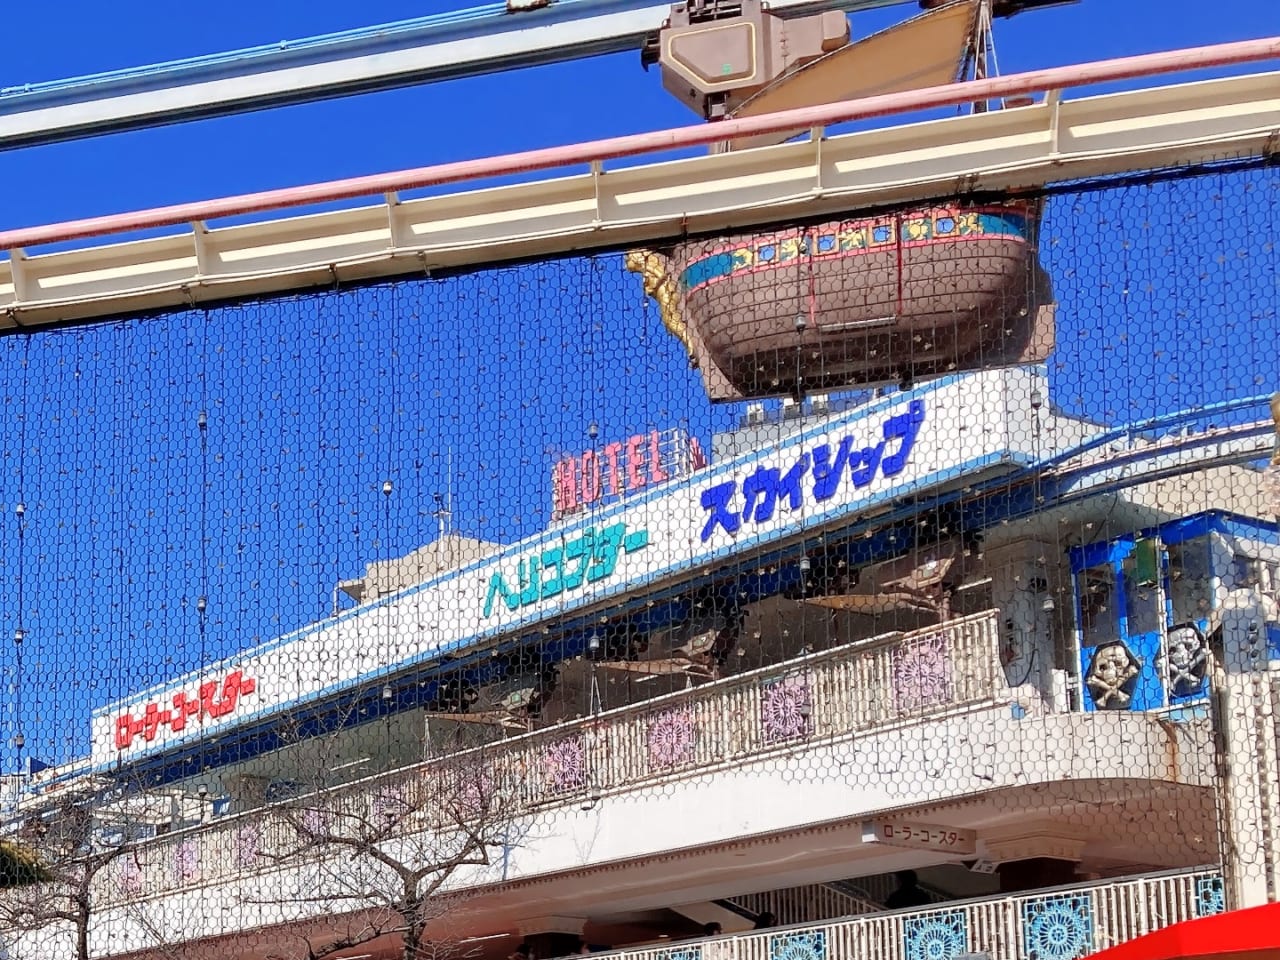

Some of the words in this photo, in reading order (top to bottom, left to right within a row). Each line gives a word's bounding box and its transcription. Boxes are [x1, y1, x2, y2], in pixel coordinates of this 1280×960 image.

[556, 429, 669, 511] HOTEL
[701, 399, 925, 543] スカイシップ
[483, 522, 649, 619] ヘリコプター
[116, 671, 256, 750] ローラーコースター
[883, 824, 965, 846] ローラーコースター
